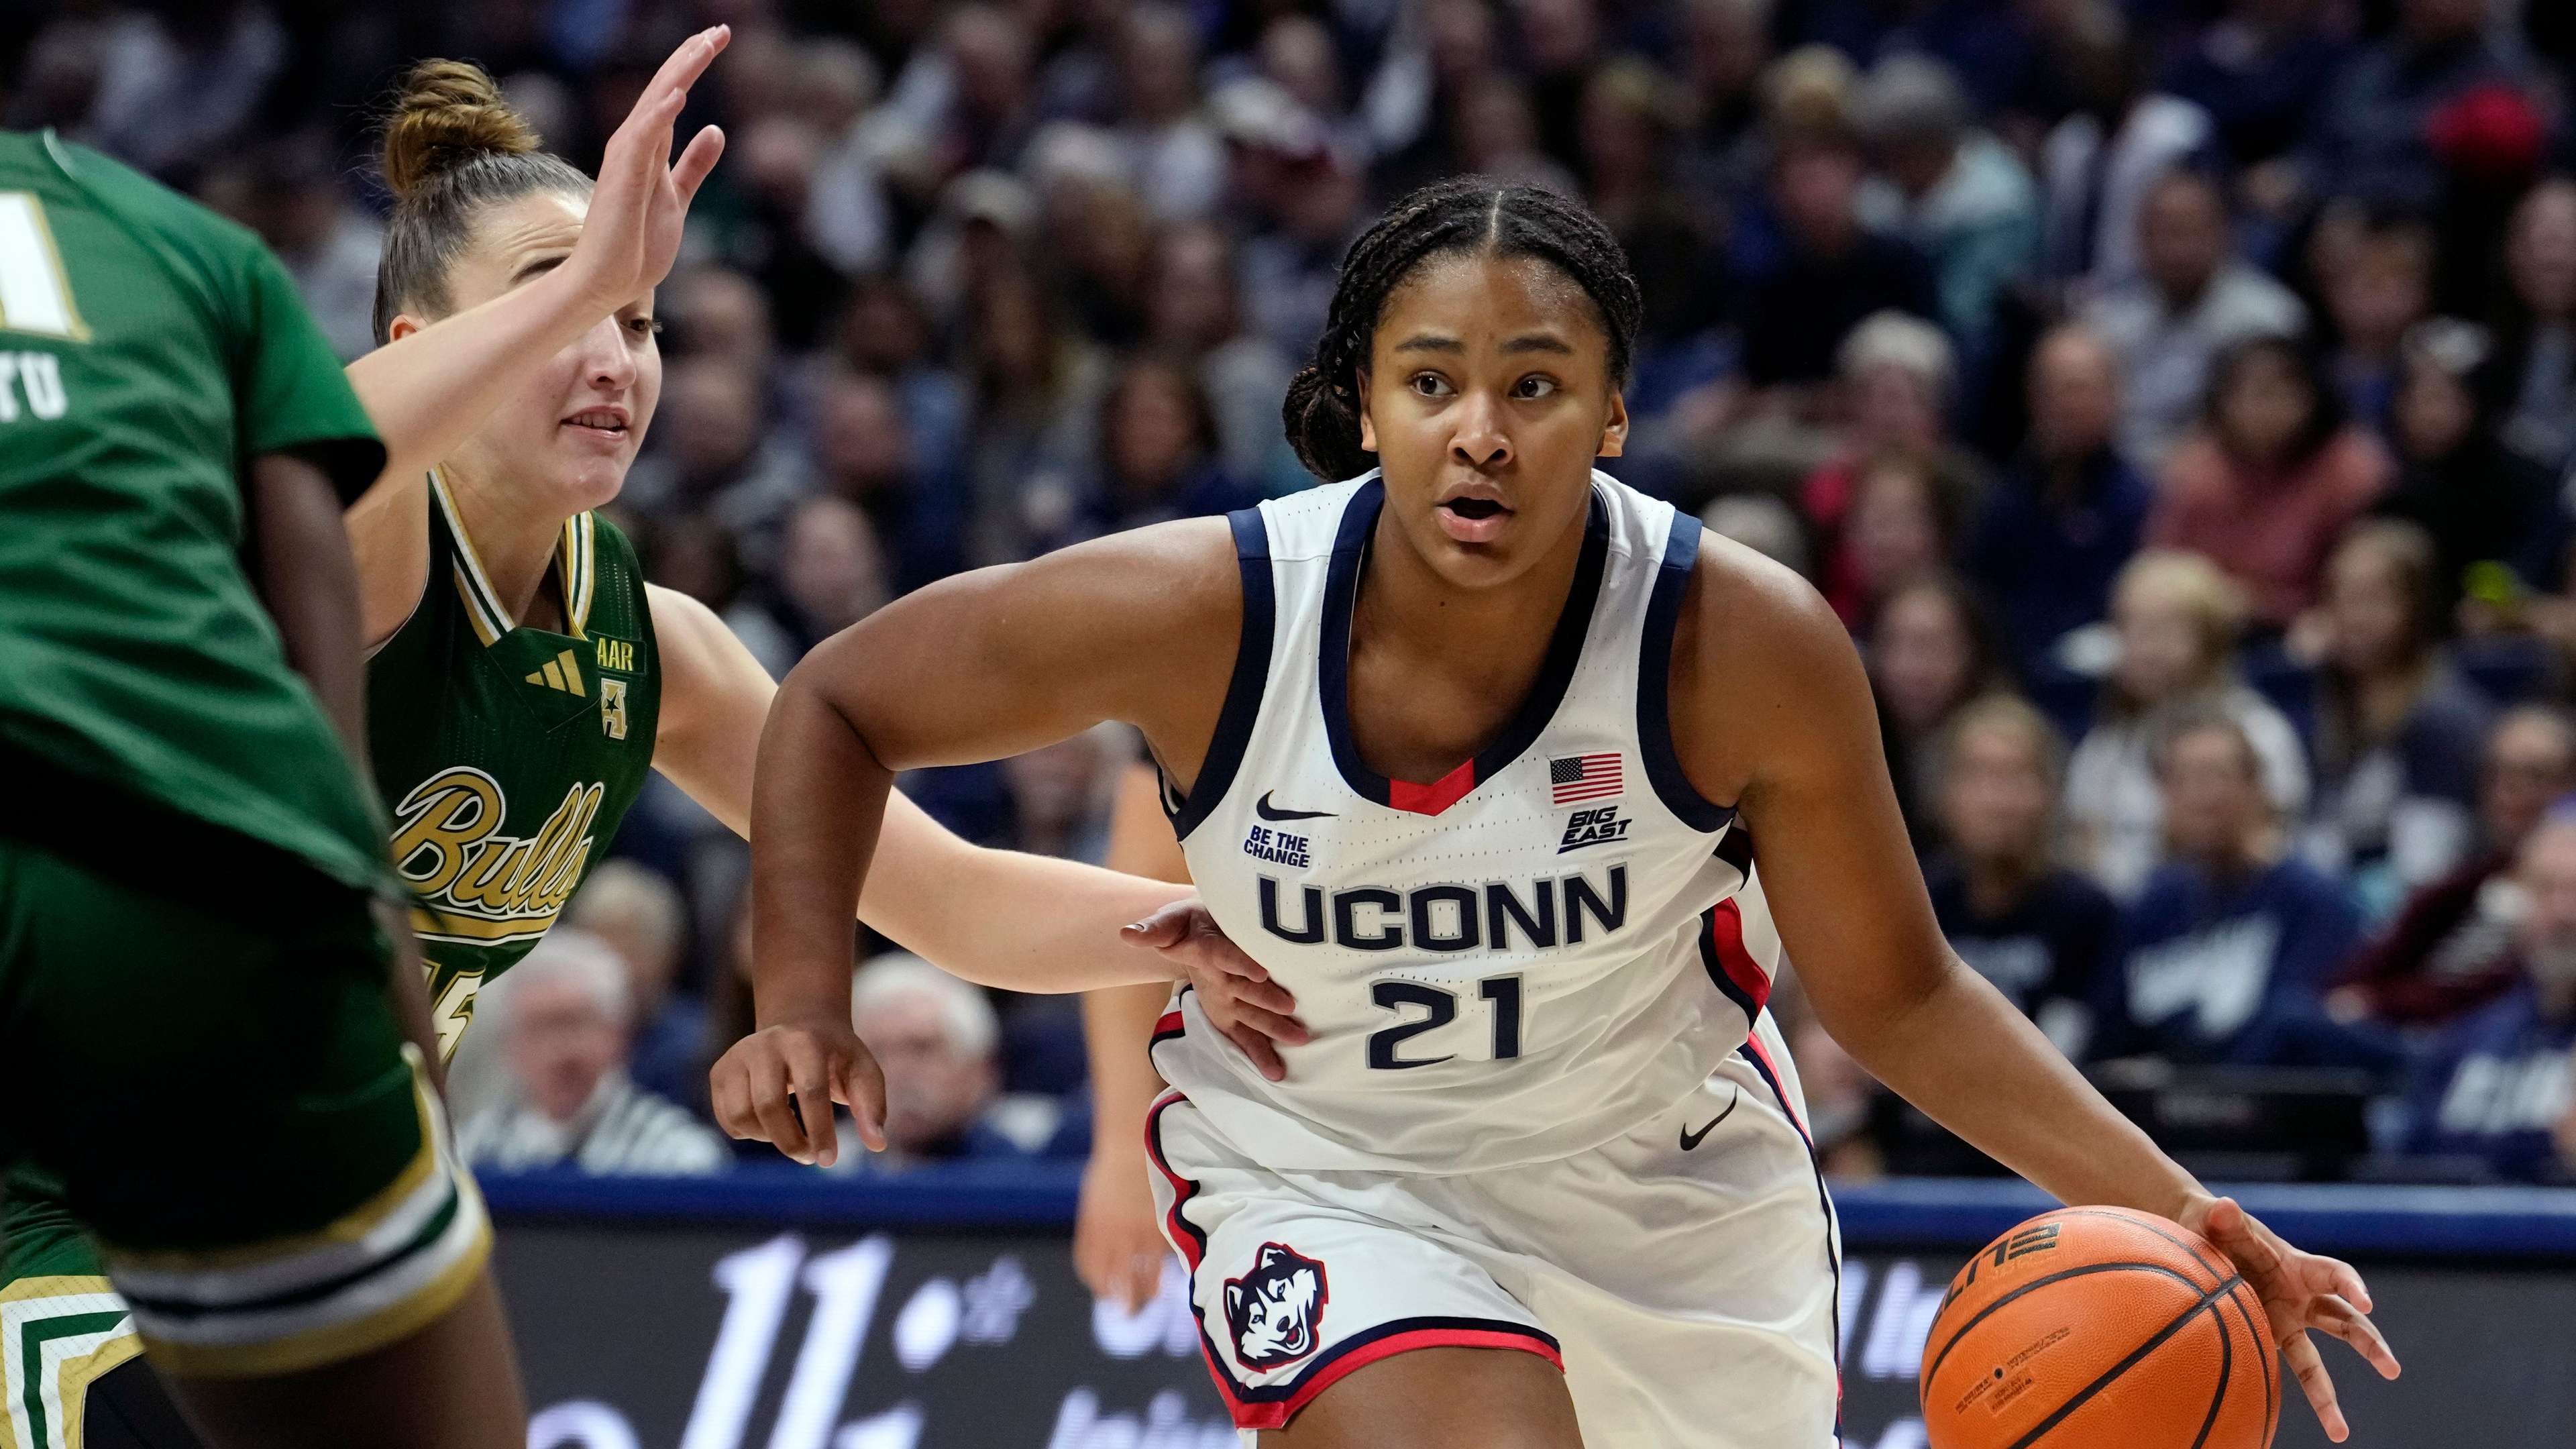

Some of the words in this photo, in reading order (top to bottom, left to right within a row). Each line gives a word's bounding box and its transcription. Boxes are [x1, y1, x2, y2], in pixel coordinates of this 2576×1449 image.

[1561, 818, 1633, 845] EAST
[1567, 805, 1619, 829] BIG
[1250, 824, 1273, 845] BE
[1277, 832, 1309, 853] THE
[1244, 839, 1311, 868] CHANGE
[1256, 861, 1630, 953] UCONN
[1364, 972, 1523, 1069] 21
